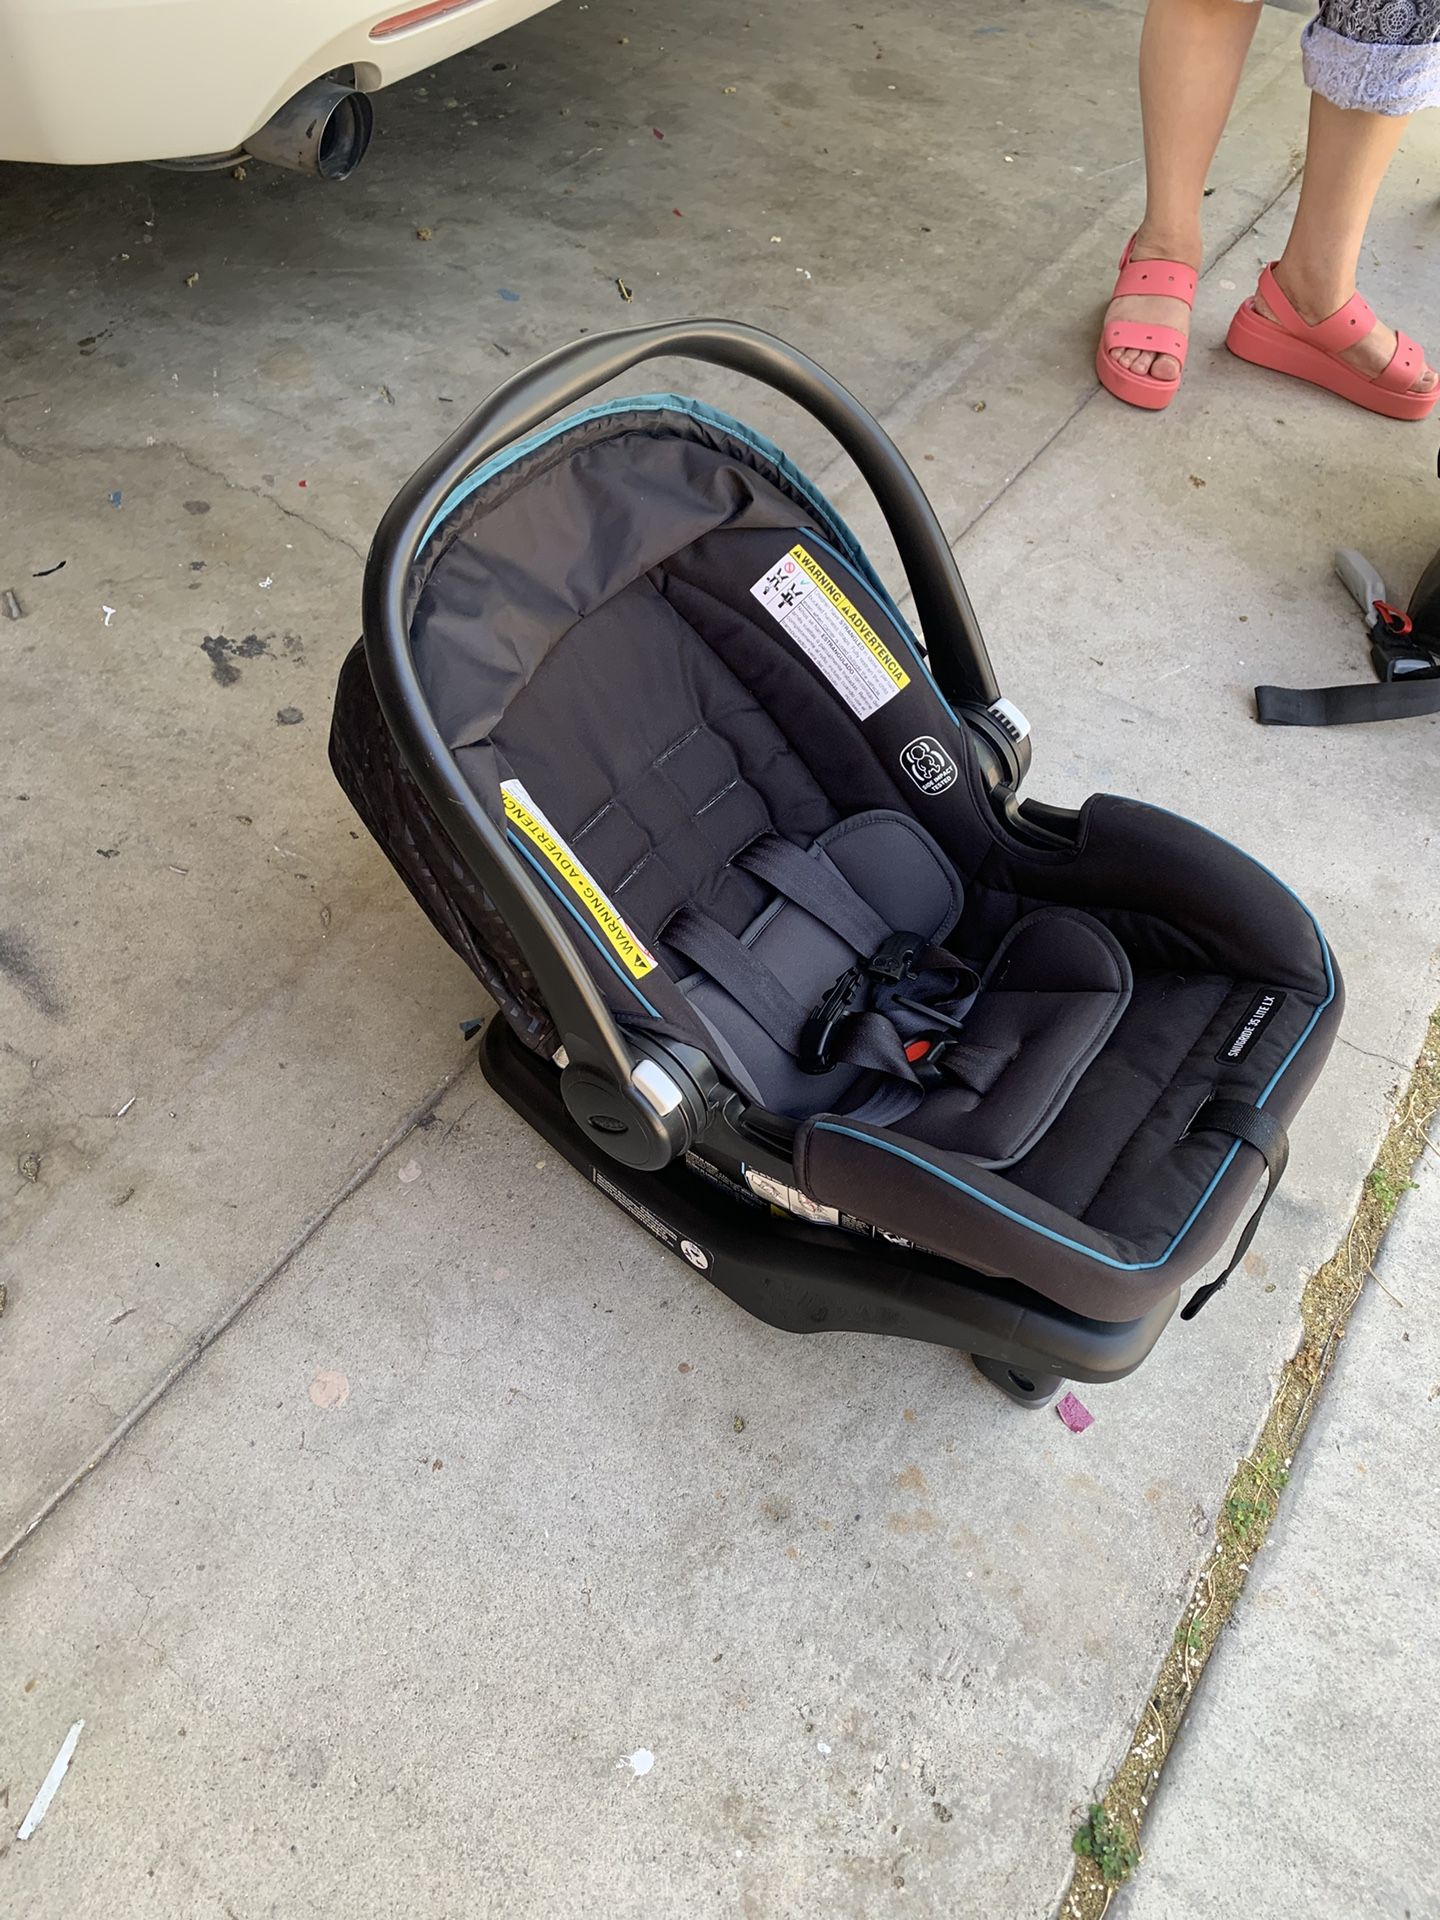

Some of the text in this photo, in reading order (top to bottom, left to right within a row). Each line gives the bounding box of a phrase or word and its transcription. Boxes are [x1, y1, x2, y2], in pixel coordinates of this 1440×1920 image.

[801, 554, 841, 603] WARNING
[819, 633, 856, 675] ESTRANGULADO
[838, 618, 865, 651] STRANGLED
[848, 612, 902, 682] ADVERTENCIA
[931, 775, 952, 791] TESTED
[933, 765, 953, 782] IMPACT
[583, 887, 634, 955] WARNING
[1227, 995, 1275, 1057] SNUGRIDE 35 LITE LX
